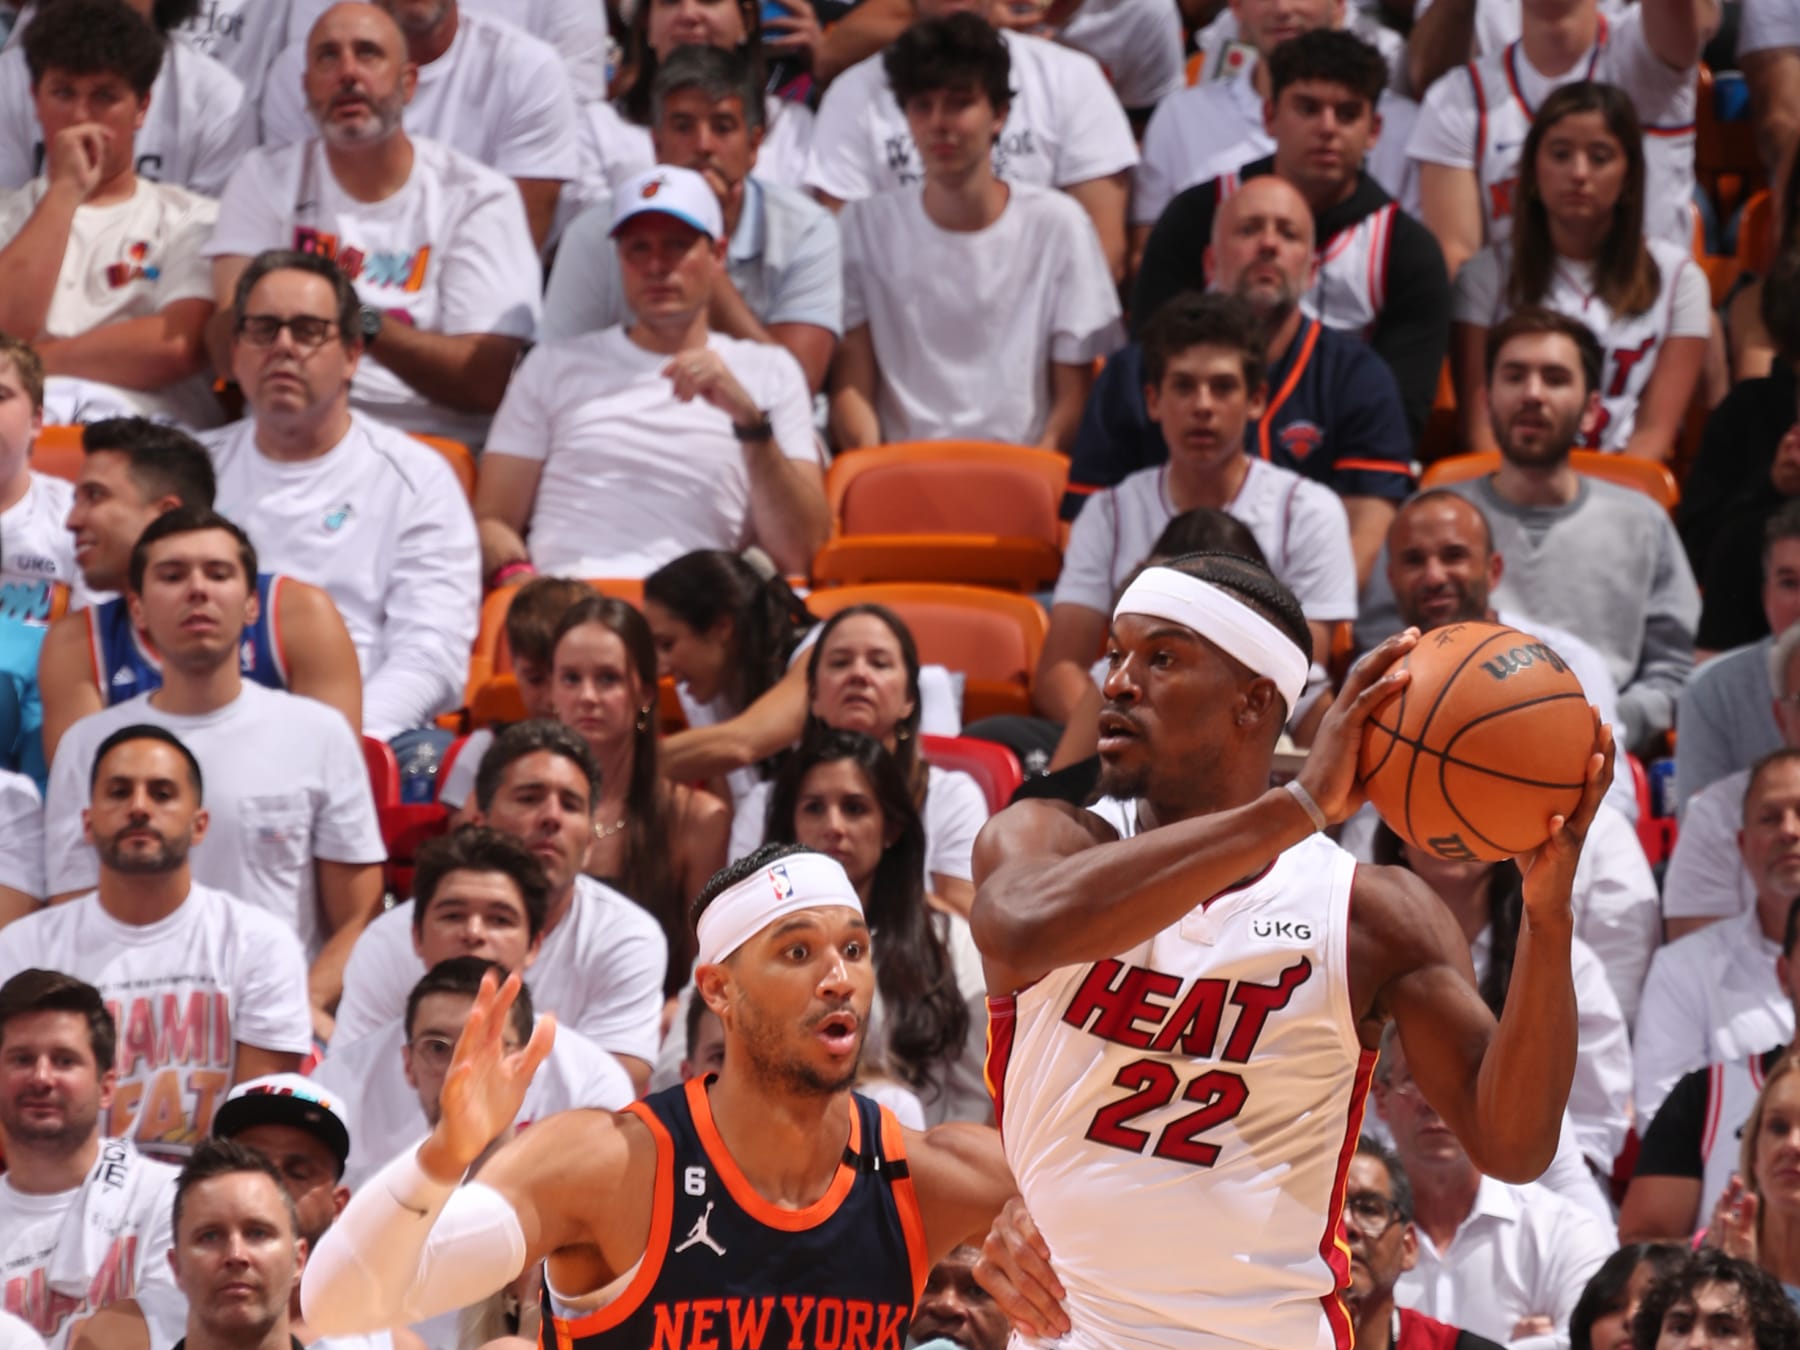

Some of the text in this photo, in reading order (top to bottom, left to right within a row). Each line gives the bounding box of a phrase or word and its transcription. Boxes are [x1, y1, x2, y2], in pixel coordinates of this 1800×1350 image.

[1061, 955, 1312, 1064] HEAT
[1084, 1058, 1250, 1168] 22
[684, 1166, 707, 1196] 6
